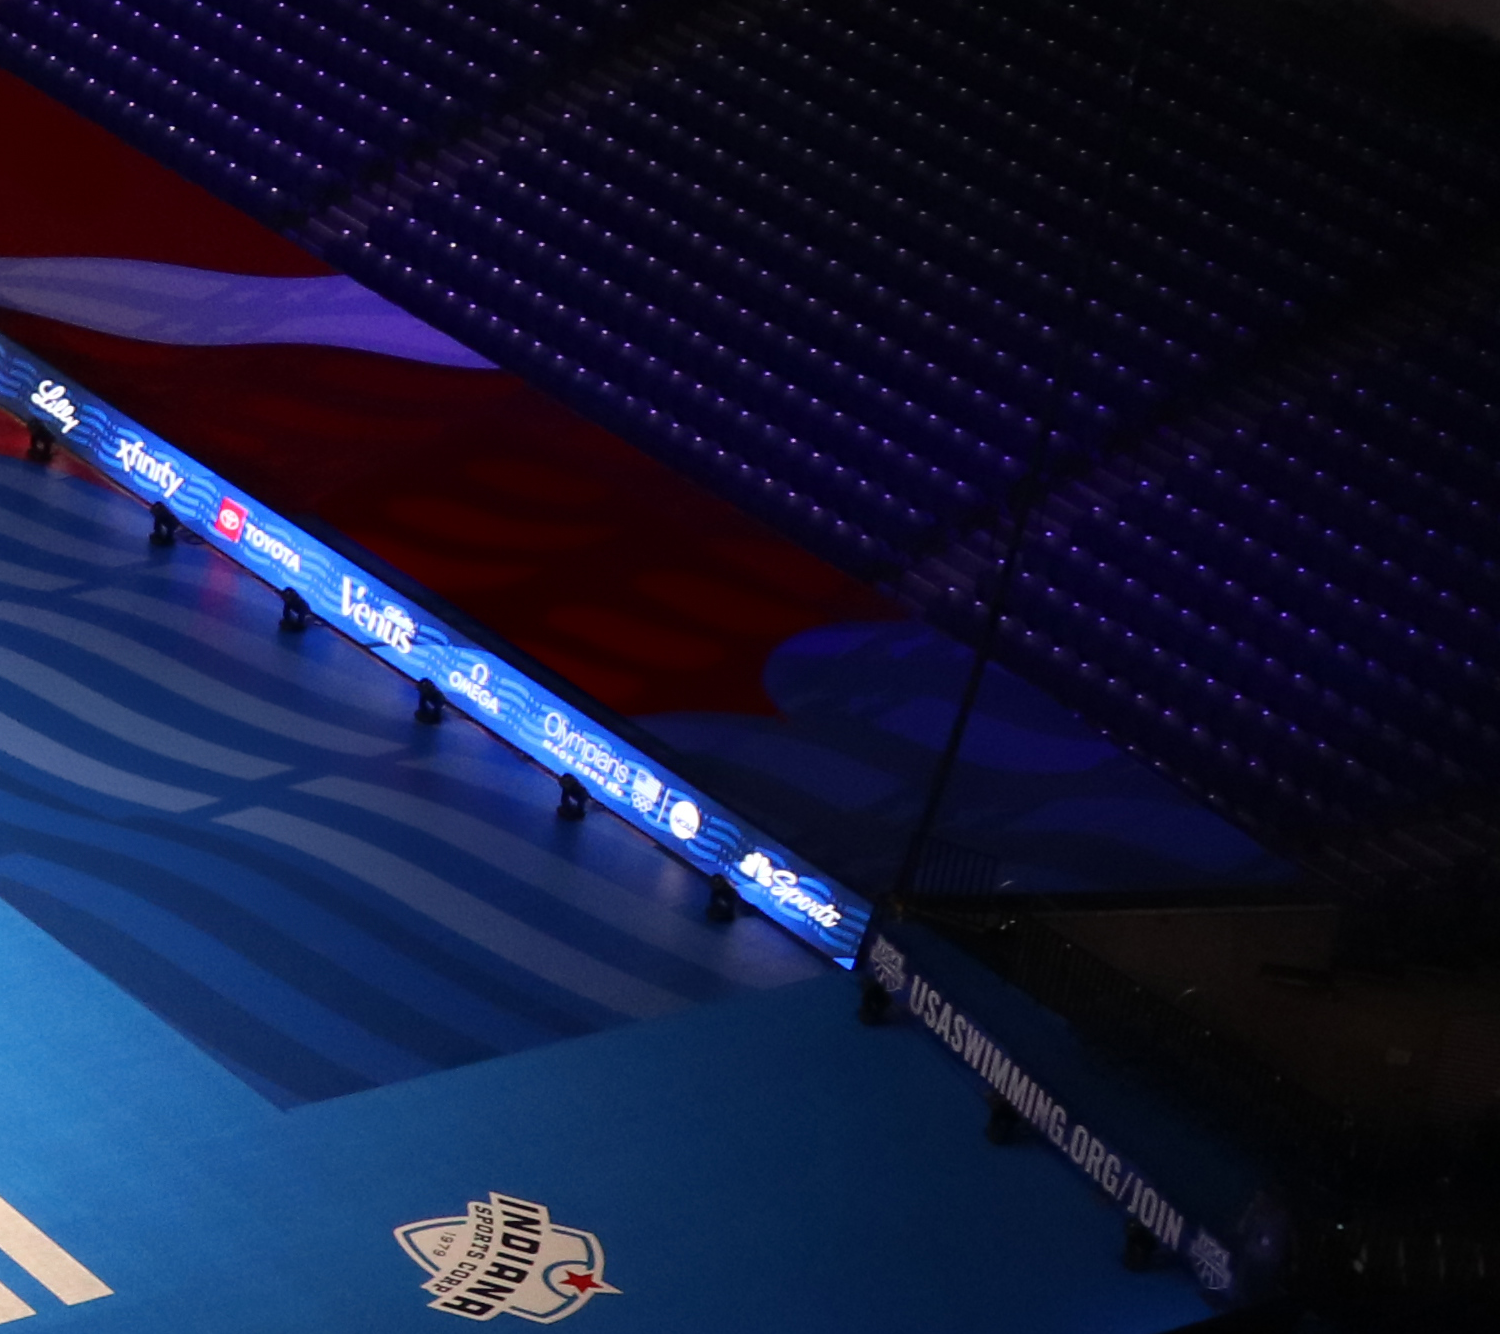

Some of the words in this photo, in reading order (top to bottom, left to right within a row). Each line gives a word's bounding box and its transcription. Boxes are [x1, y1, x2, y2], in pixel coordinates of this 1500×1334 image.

[30, 379, 79, 435] Lilly
[113, 438, 183, 498] xfinity
[244, 521, 301, 572] TOYOTA
[341, 574, 414, 654] Venus
[449, 670, 500, 714] OMEGA
[544, 712, 630, 784] Olympians
[771, 868, 842, 929] Sports
[908, 973, 1186, 1252] USASWIMMING.ORG/JOIN
[433, 1231, 457, 1257] 1979
[440, 1198, 543, 1317] INDIANA
[467, 1205, 493, 1260] SPORTS
[433, 1261, 477, 1294] CORP
